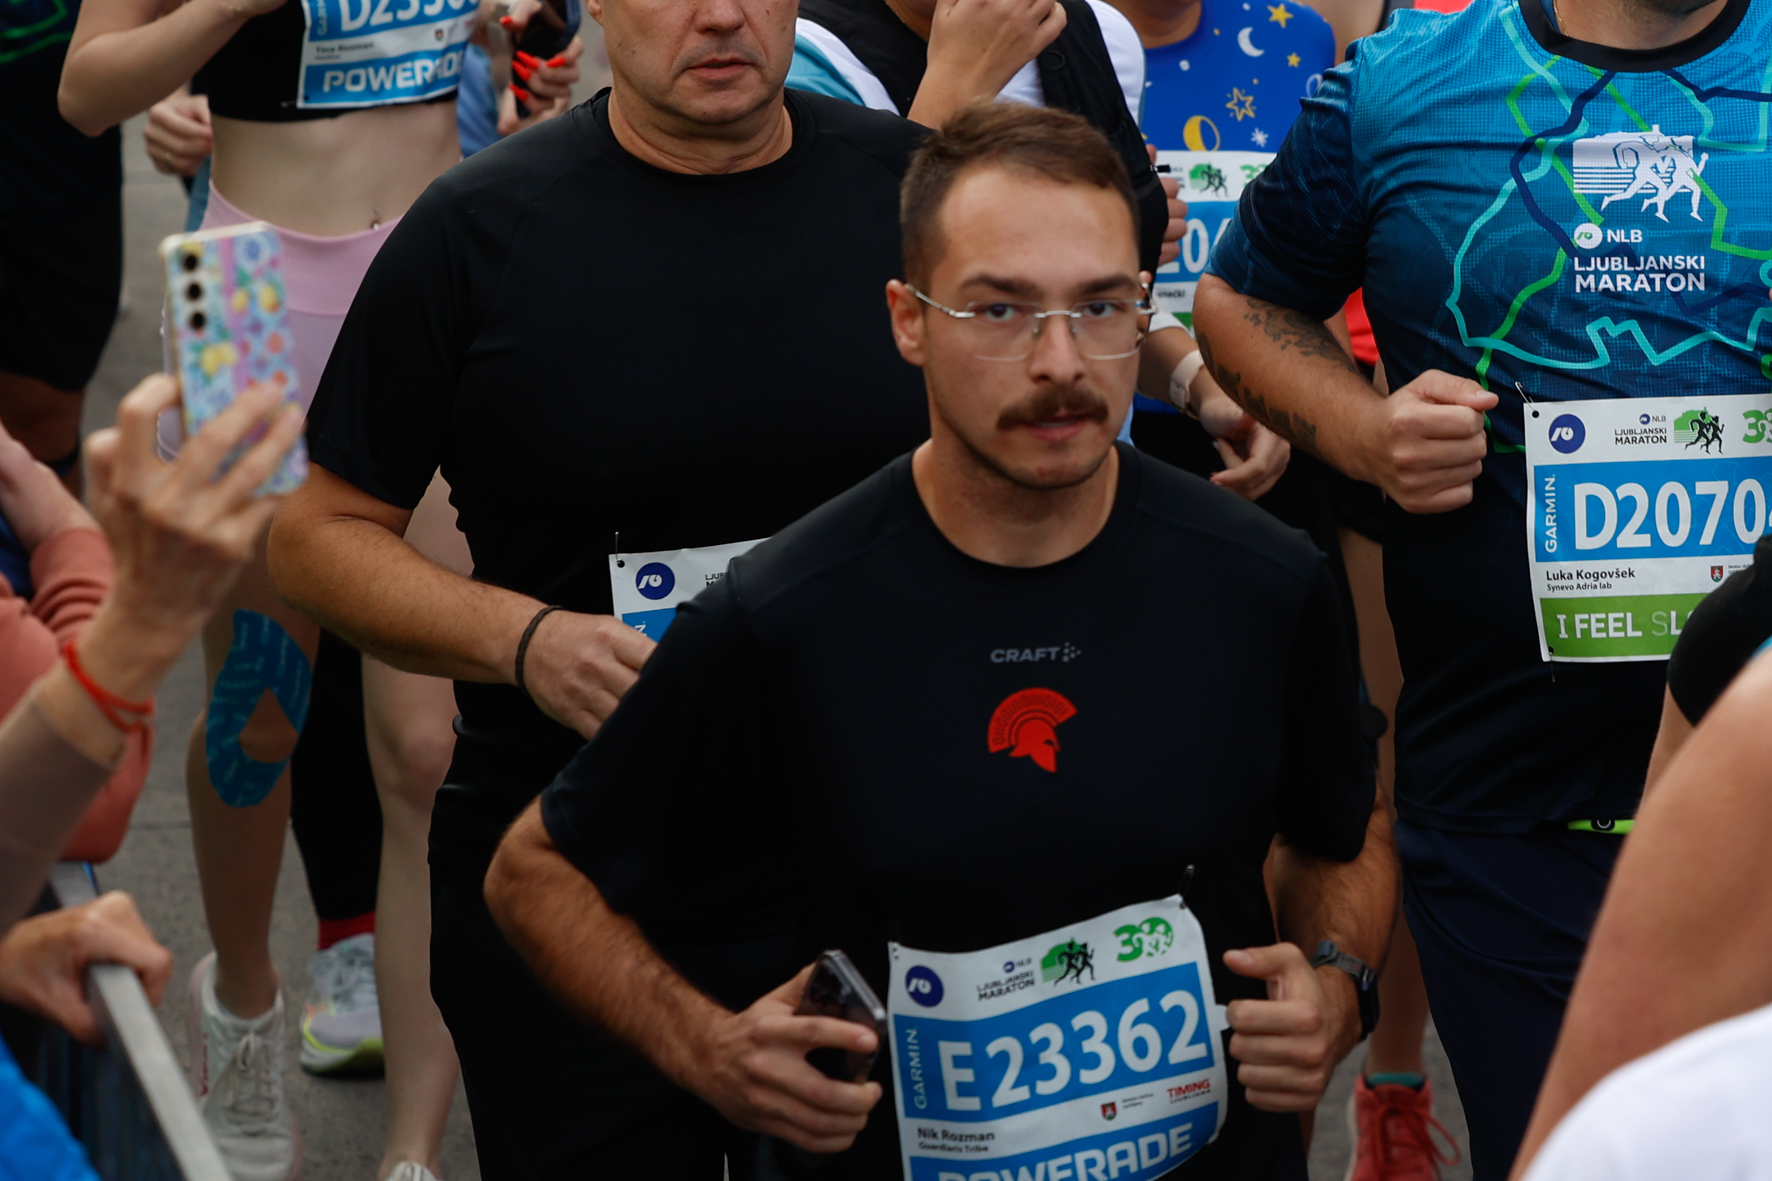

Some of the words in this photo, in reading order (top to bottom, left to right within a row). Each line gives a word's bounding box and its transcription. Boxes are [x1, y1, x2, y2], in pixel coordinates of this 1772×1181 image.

[1607, 229, 1643, 243] NLB
[1573, 255, 1706, 271] LJUBLJANSKI
[1575, 272, 1706, 293] MARATON
[1652, 415, 1667, 423] NLB
[1614, 427, 1667, 436] LJUBLJANSKI
[1614, 434, 1667, 446] MARATON
[1546, 569, 1574, 581] Luka
[1576, 567, 1636, 582] Kogovšek
[1546, 583, 1574, 593] Synevo
[1576, 582, 1598, 591] Adria
[1599, 581, 1613, 590] lab
[1556, 614, 1569, 638] I
[1574, 612, 1643, 639] FEEL
[1651, 610, 1694, 636] SL
[990, 646, 1061, 663] CRAFT
[978, 979, 1036, 1001] MARATON
[938, 989, 1208, 1111] E23362
[1167, 1079, 1211, 1098] TIMING
[917, 1127, 938, 1140] Nik
[941, 1129, 995, 1143] Rozman
